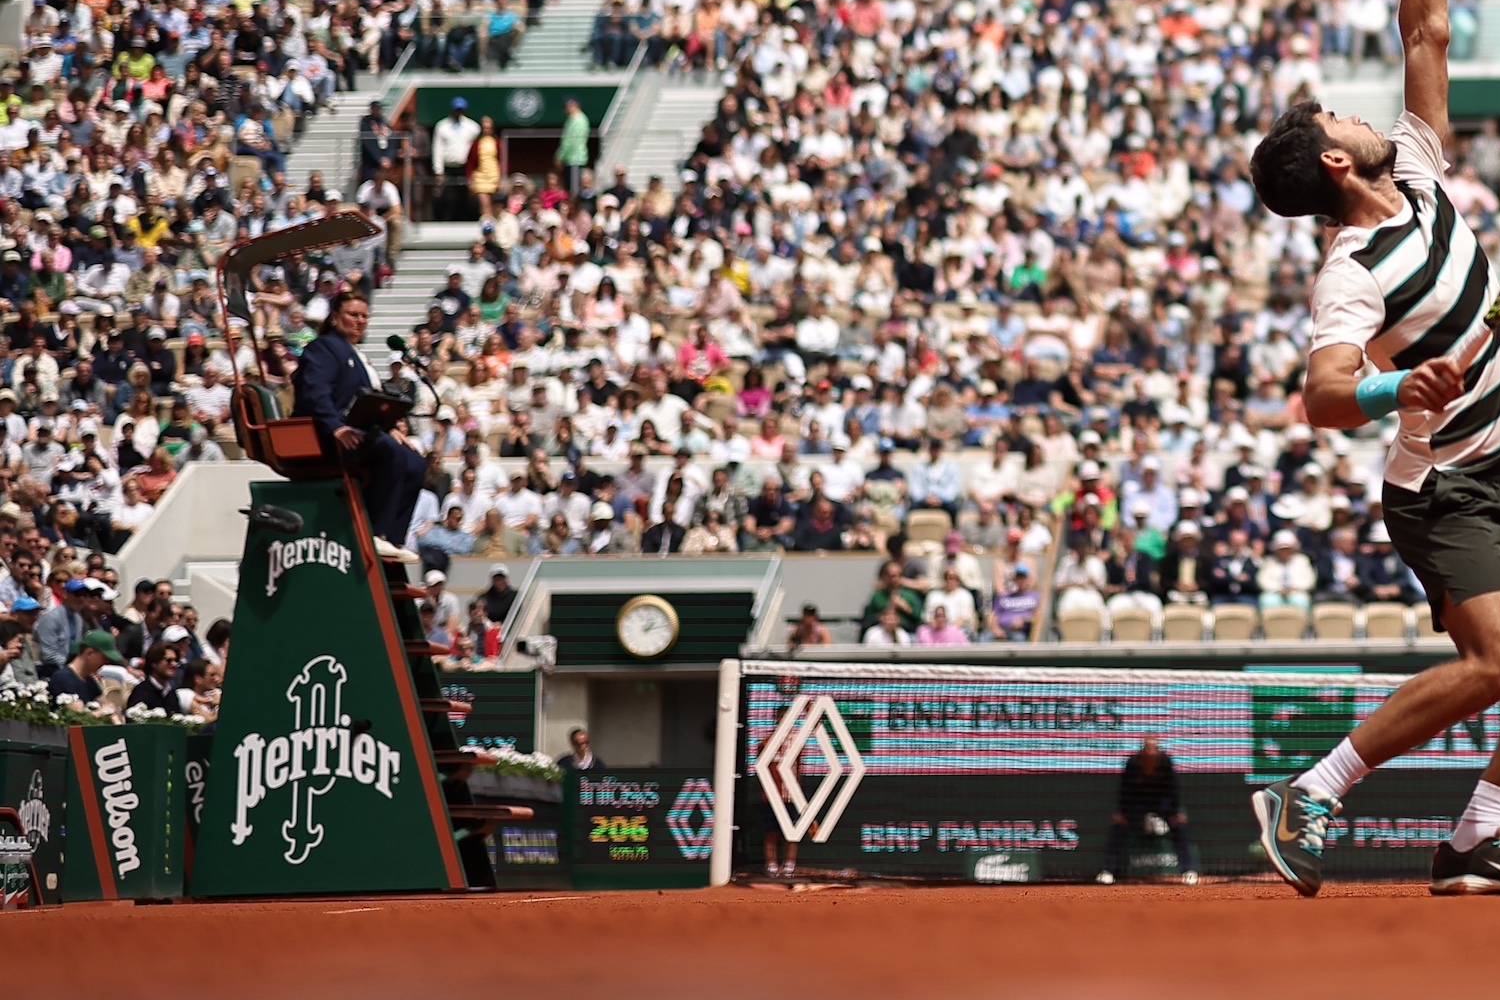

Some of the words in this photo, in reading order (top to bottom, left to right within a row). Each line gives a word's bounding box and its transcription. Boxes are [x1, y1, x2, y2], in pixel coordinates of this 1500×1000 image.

[94, 738, 141, 876] Wilson
[588, 816, 649, 843] 206
[860, 821, 933, 852] BNP
[936, 819, 1080, 851] PARIBAS
